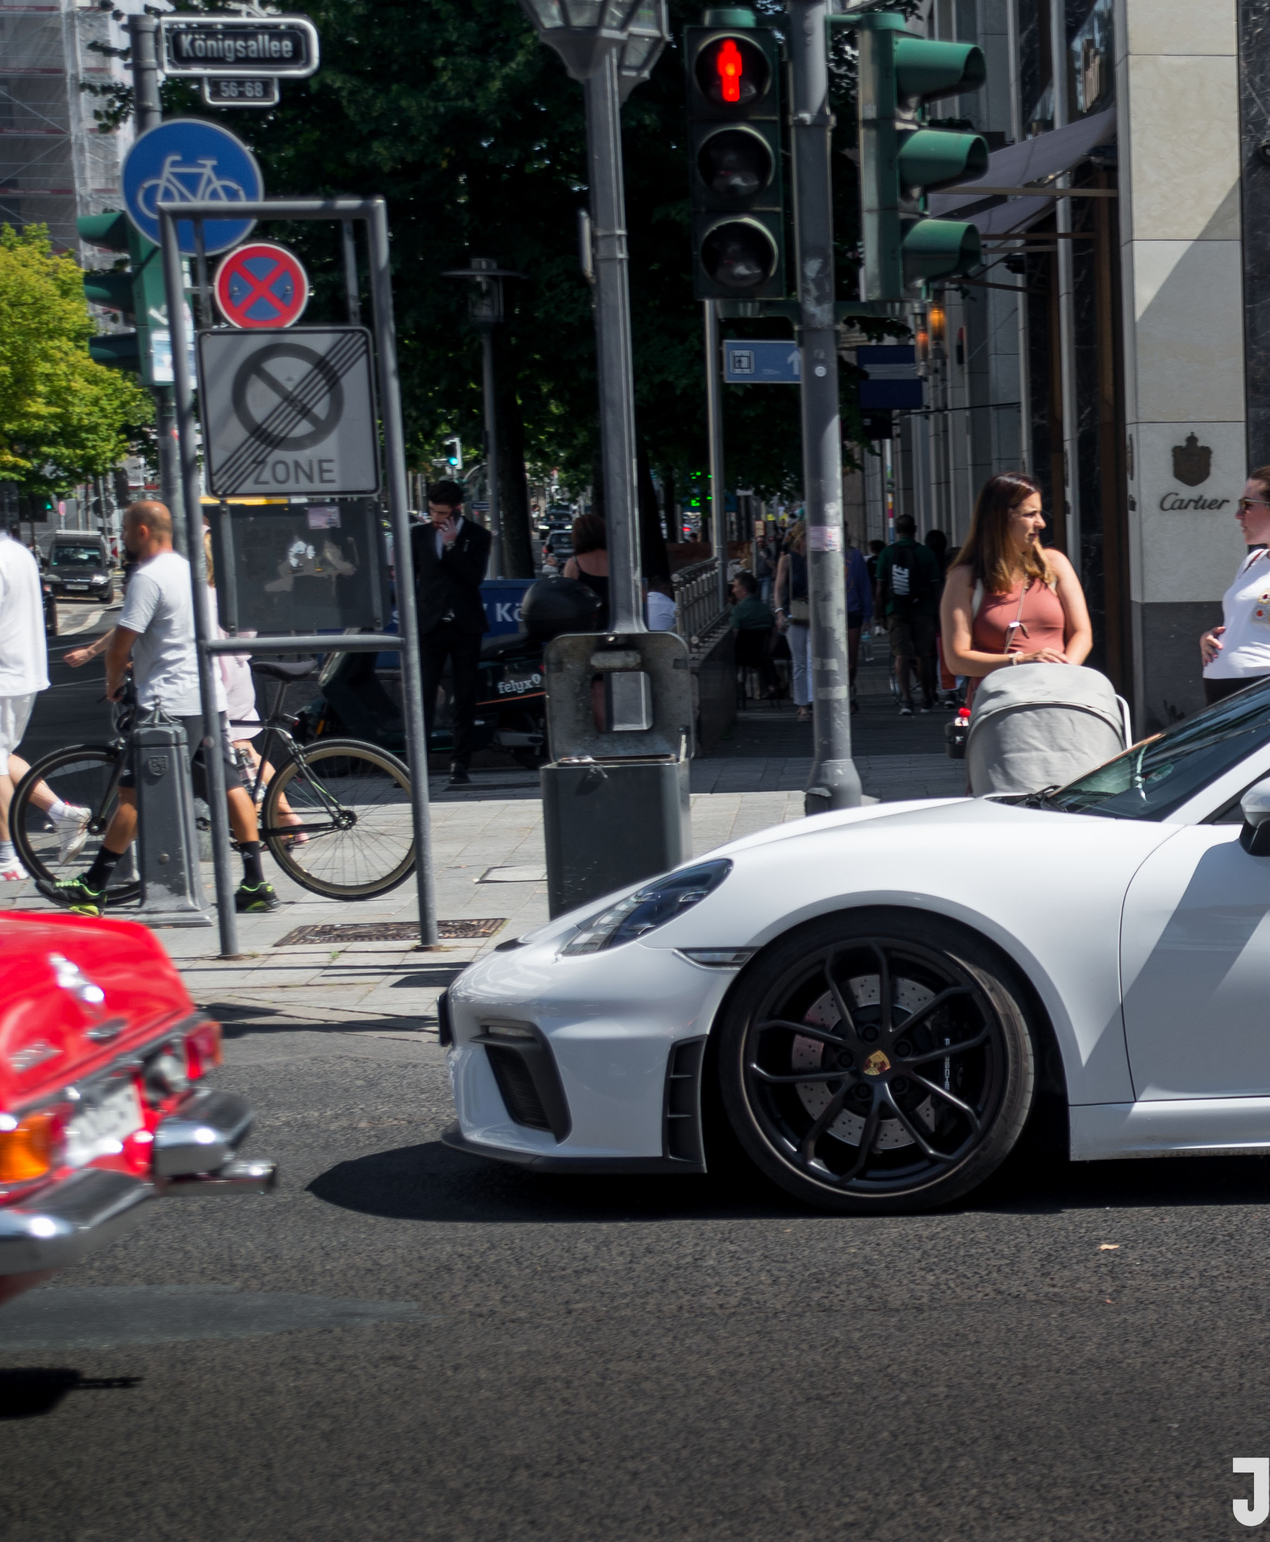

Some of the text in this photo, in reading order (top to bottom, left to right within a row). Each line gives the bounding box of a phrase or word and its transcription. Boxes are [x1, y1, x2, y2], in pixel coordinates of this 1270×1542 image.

[180, 33, 294, 62] Königsallee
[220, 82, 264, 98] 56-68
[252, 458, 337, 485] ZONE
[1159, 492, 1230, 511] Cartier
[892, 564, 910, 596] NIKE
